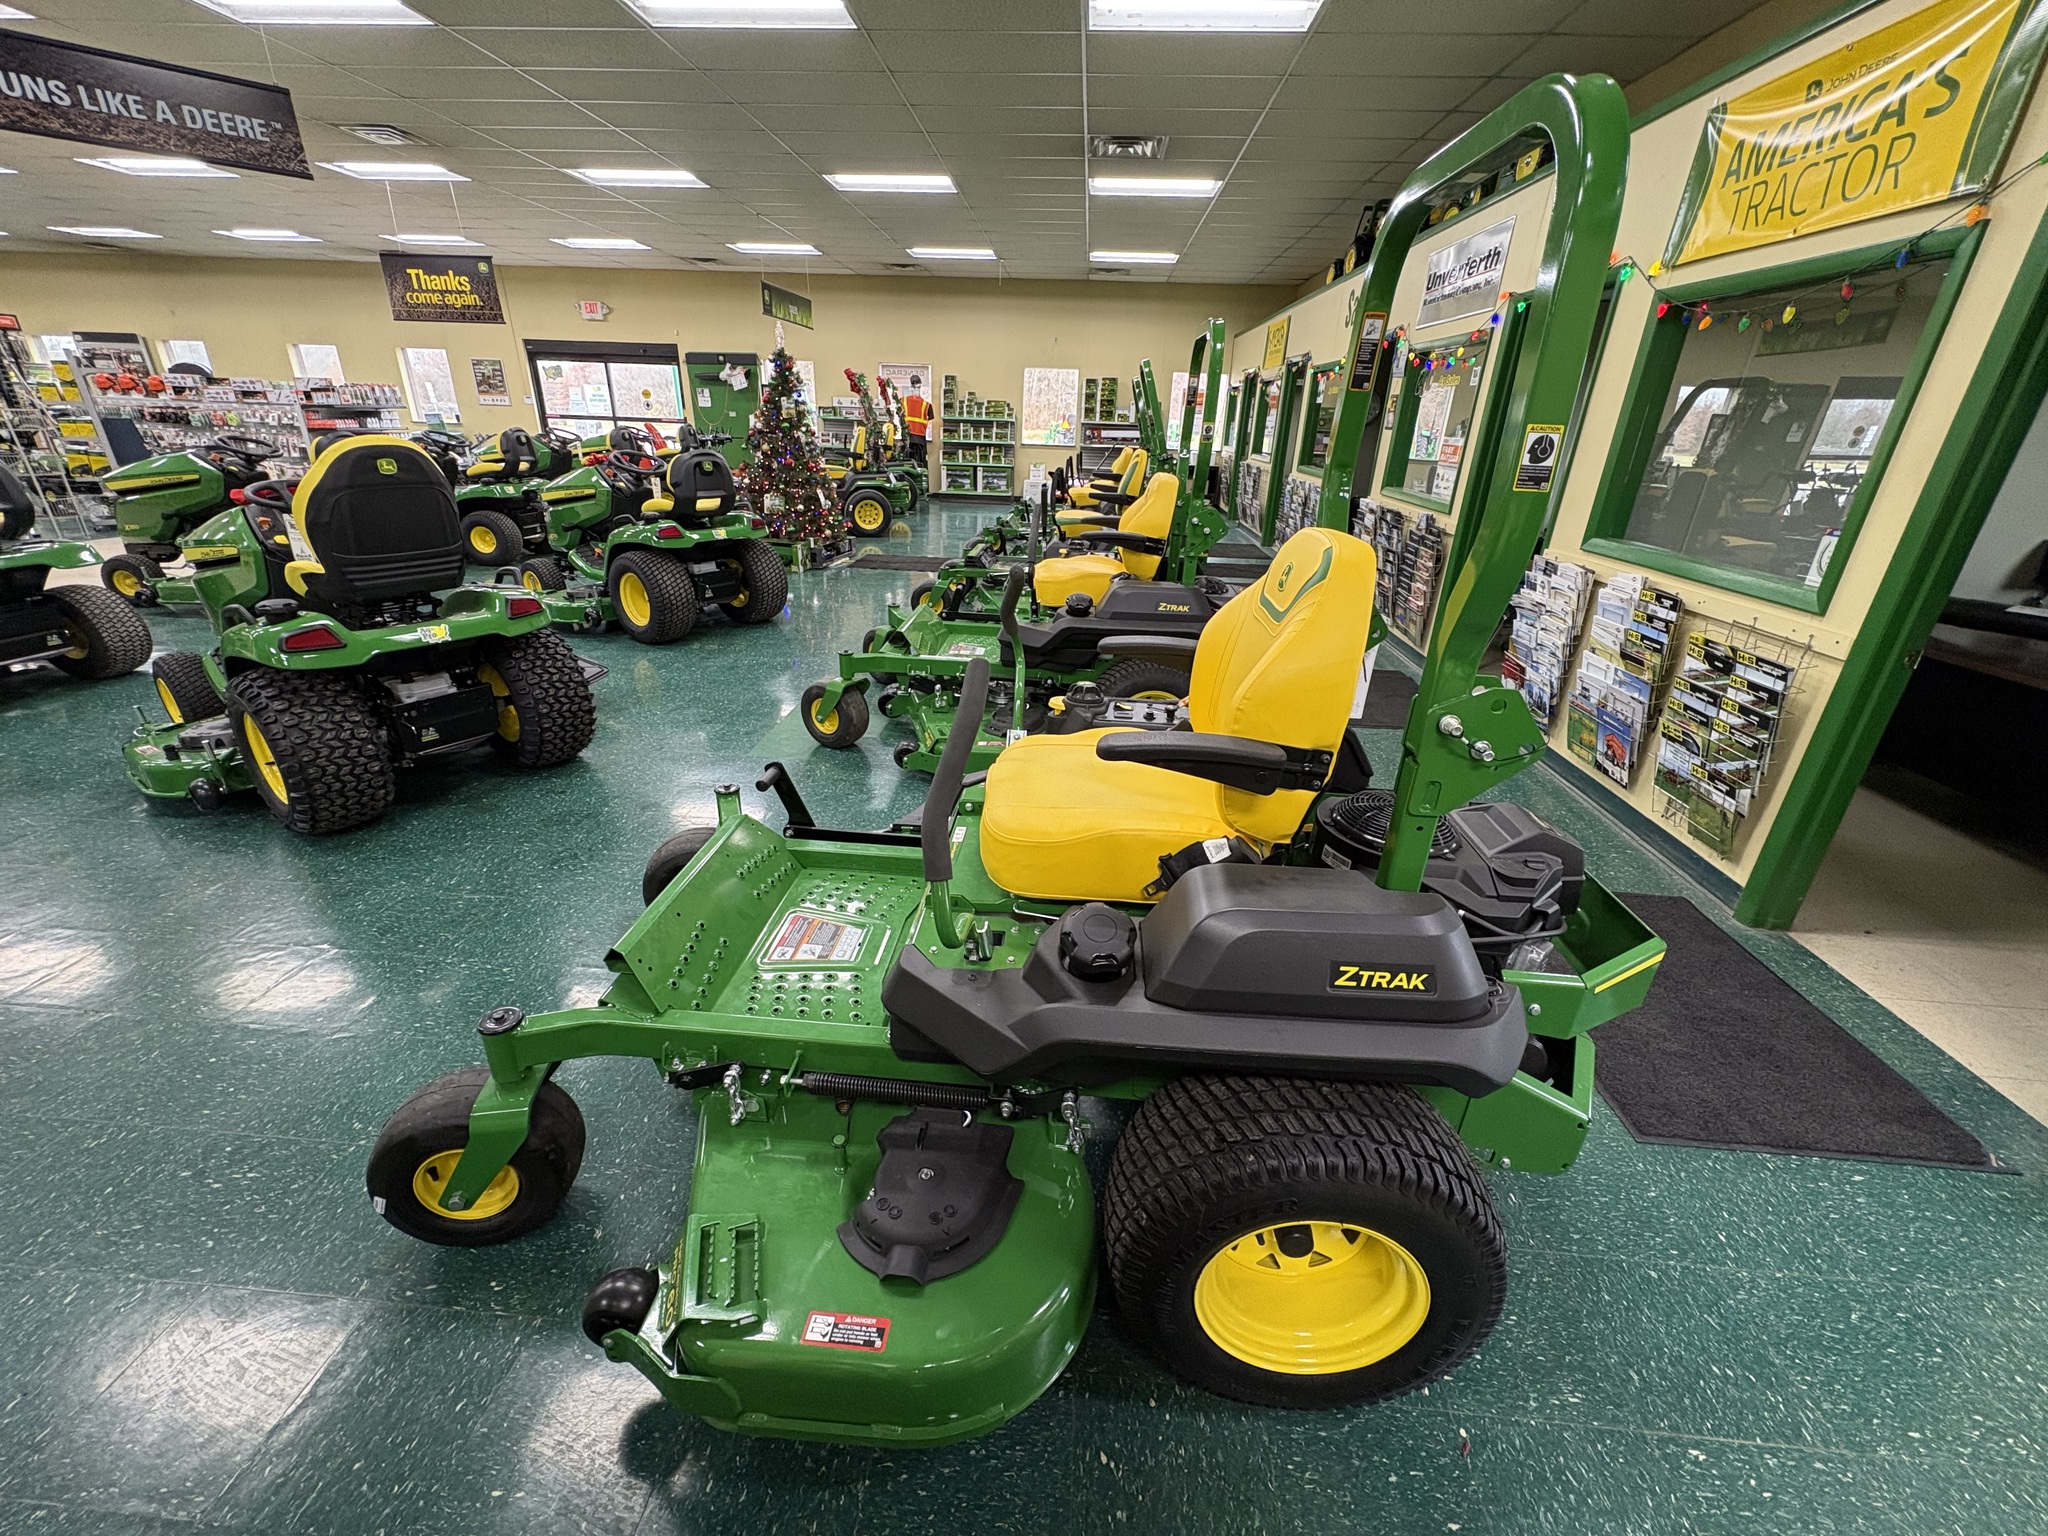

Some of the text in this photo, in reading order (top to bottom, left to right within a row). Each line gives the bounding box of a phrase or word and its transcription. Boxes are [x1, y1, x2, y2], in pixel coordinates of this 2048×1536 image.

[1826, 51, 1900, 92] JOHN DEERE
[76, 84, 148, 121] LIKE
[155, 99, 178, 126] A
[1720, 46, 1971, 189] AMERICA'S
[1728, 131, 1917, 235] TRACTOR
[406, 268, 471, 292] Thanks
[1426, 246, 1502, 291] Unverferth
[405, 290, 484, 308] come again.
[584, 302, 599, 314] EXIT
[1157, 602, 1190, 613] ZTRAK
[1334, 966, 1430, 990] ZTRAK
[665, 1288, 675, 1327] 60
[838, 1323, 861, 1331] ROTATING
[851, 1316, 877, 1325] DANGER
